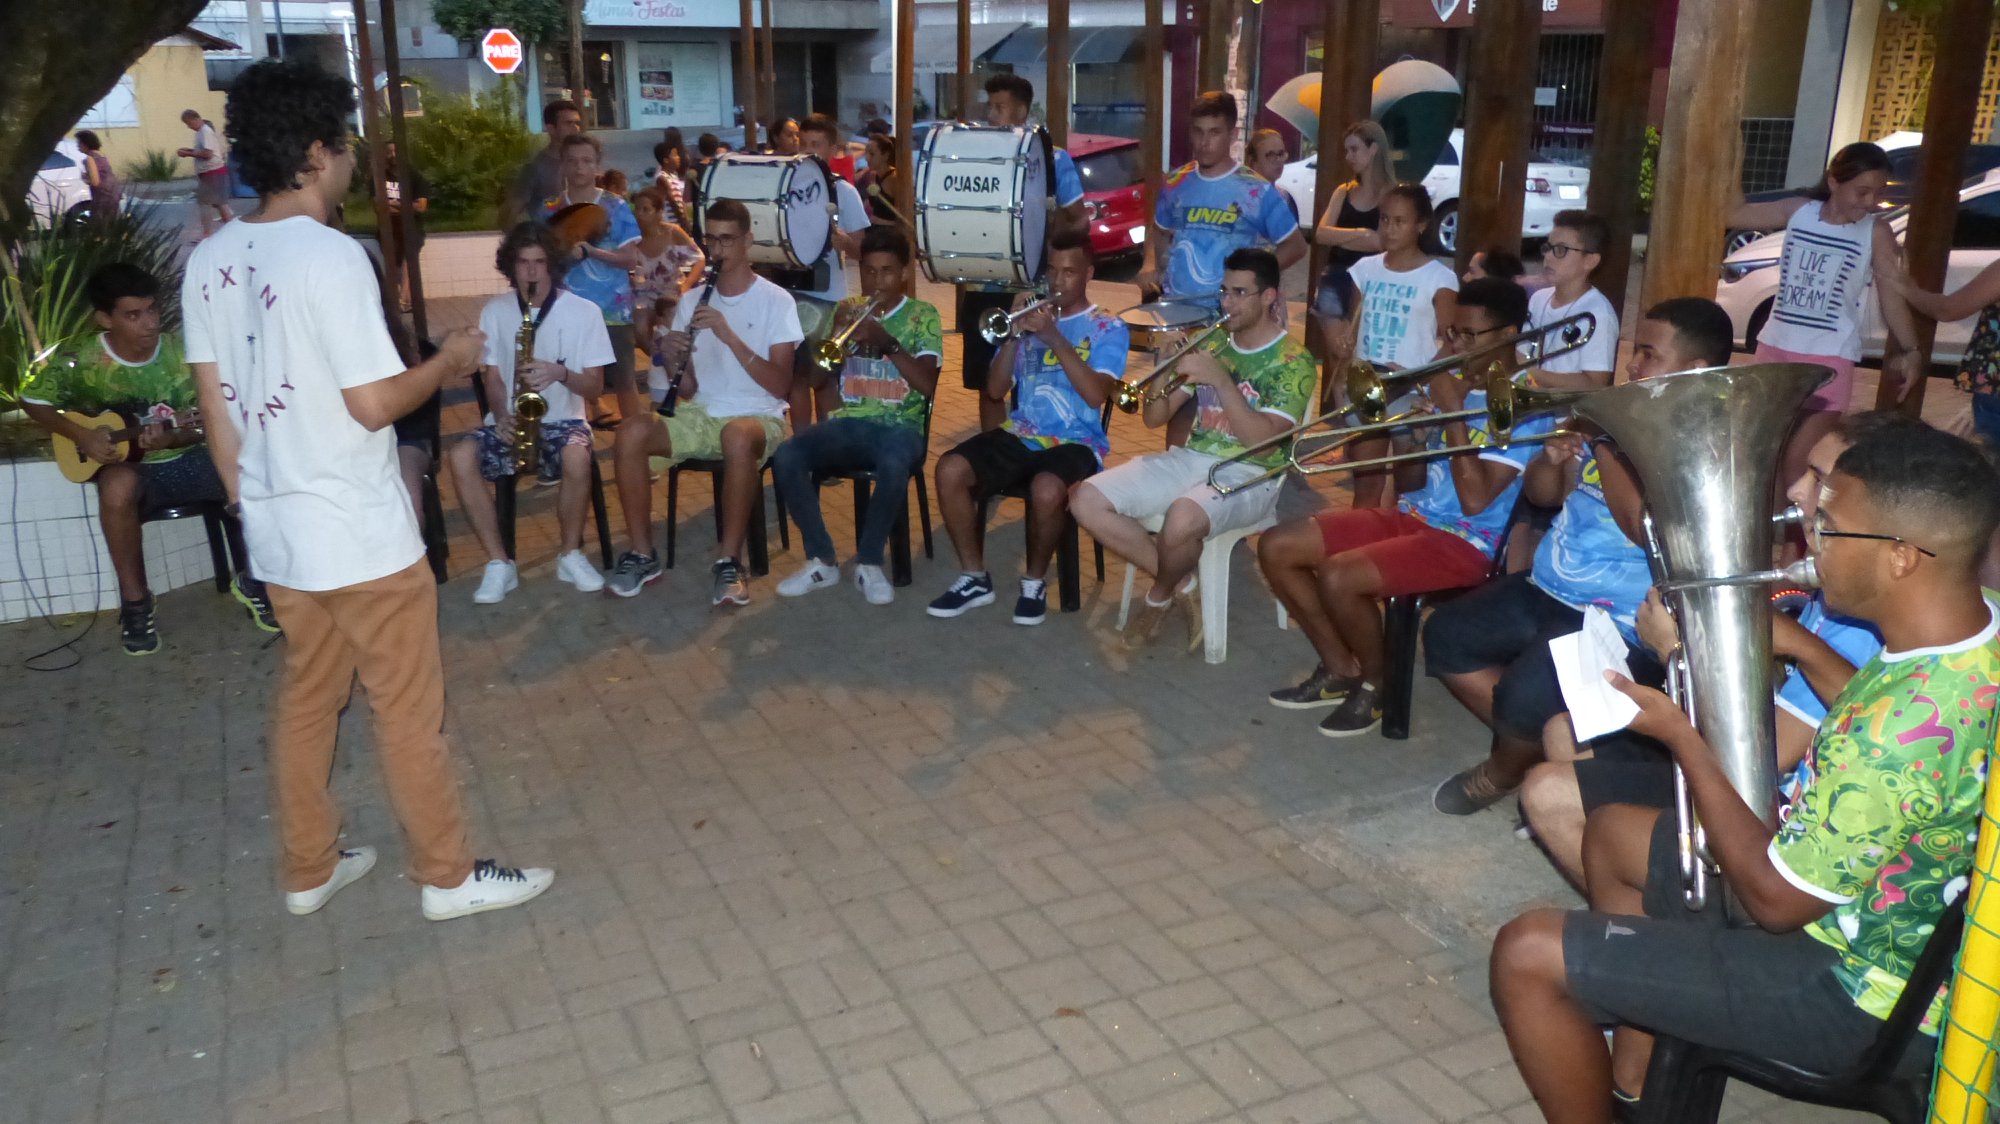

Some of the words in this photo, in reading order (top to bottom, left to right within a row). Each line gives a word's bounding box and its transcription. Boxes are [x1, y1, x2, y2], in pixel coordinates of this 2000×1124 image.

[638, 0, 686, 20] Festas
[486, 44, 518, 58] PARE
[943, 175, 1000, 193] QUASAR
[1187, 207, 1238, 225] UNIP
[1799, 250, 1831, 274] LIVE
[1803, 272, 1817, 287] THE
[1371, 297, 1400, 313] THE
[1784, 284, 1827, 311] DREAM
[1363, 312, 1409, 337] SUN
[1363, 335, 1401, 360] SET
